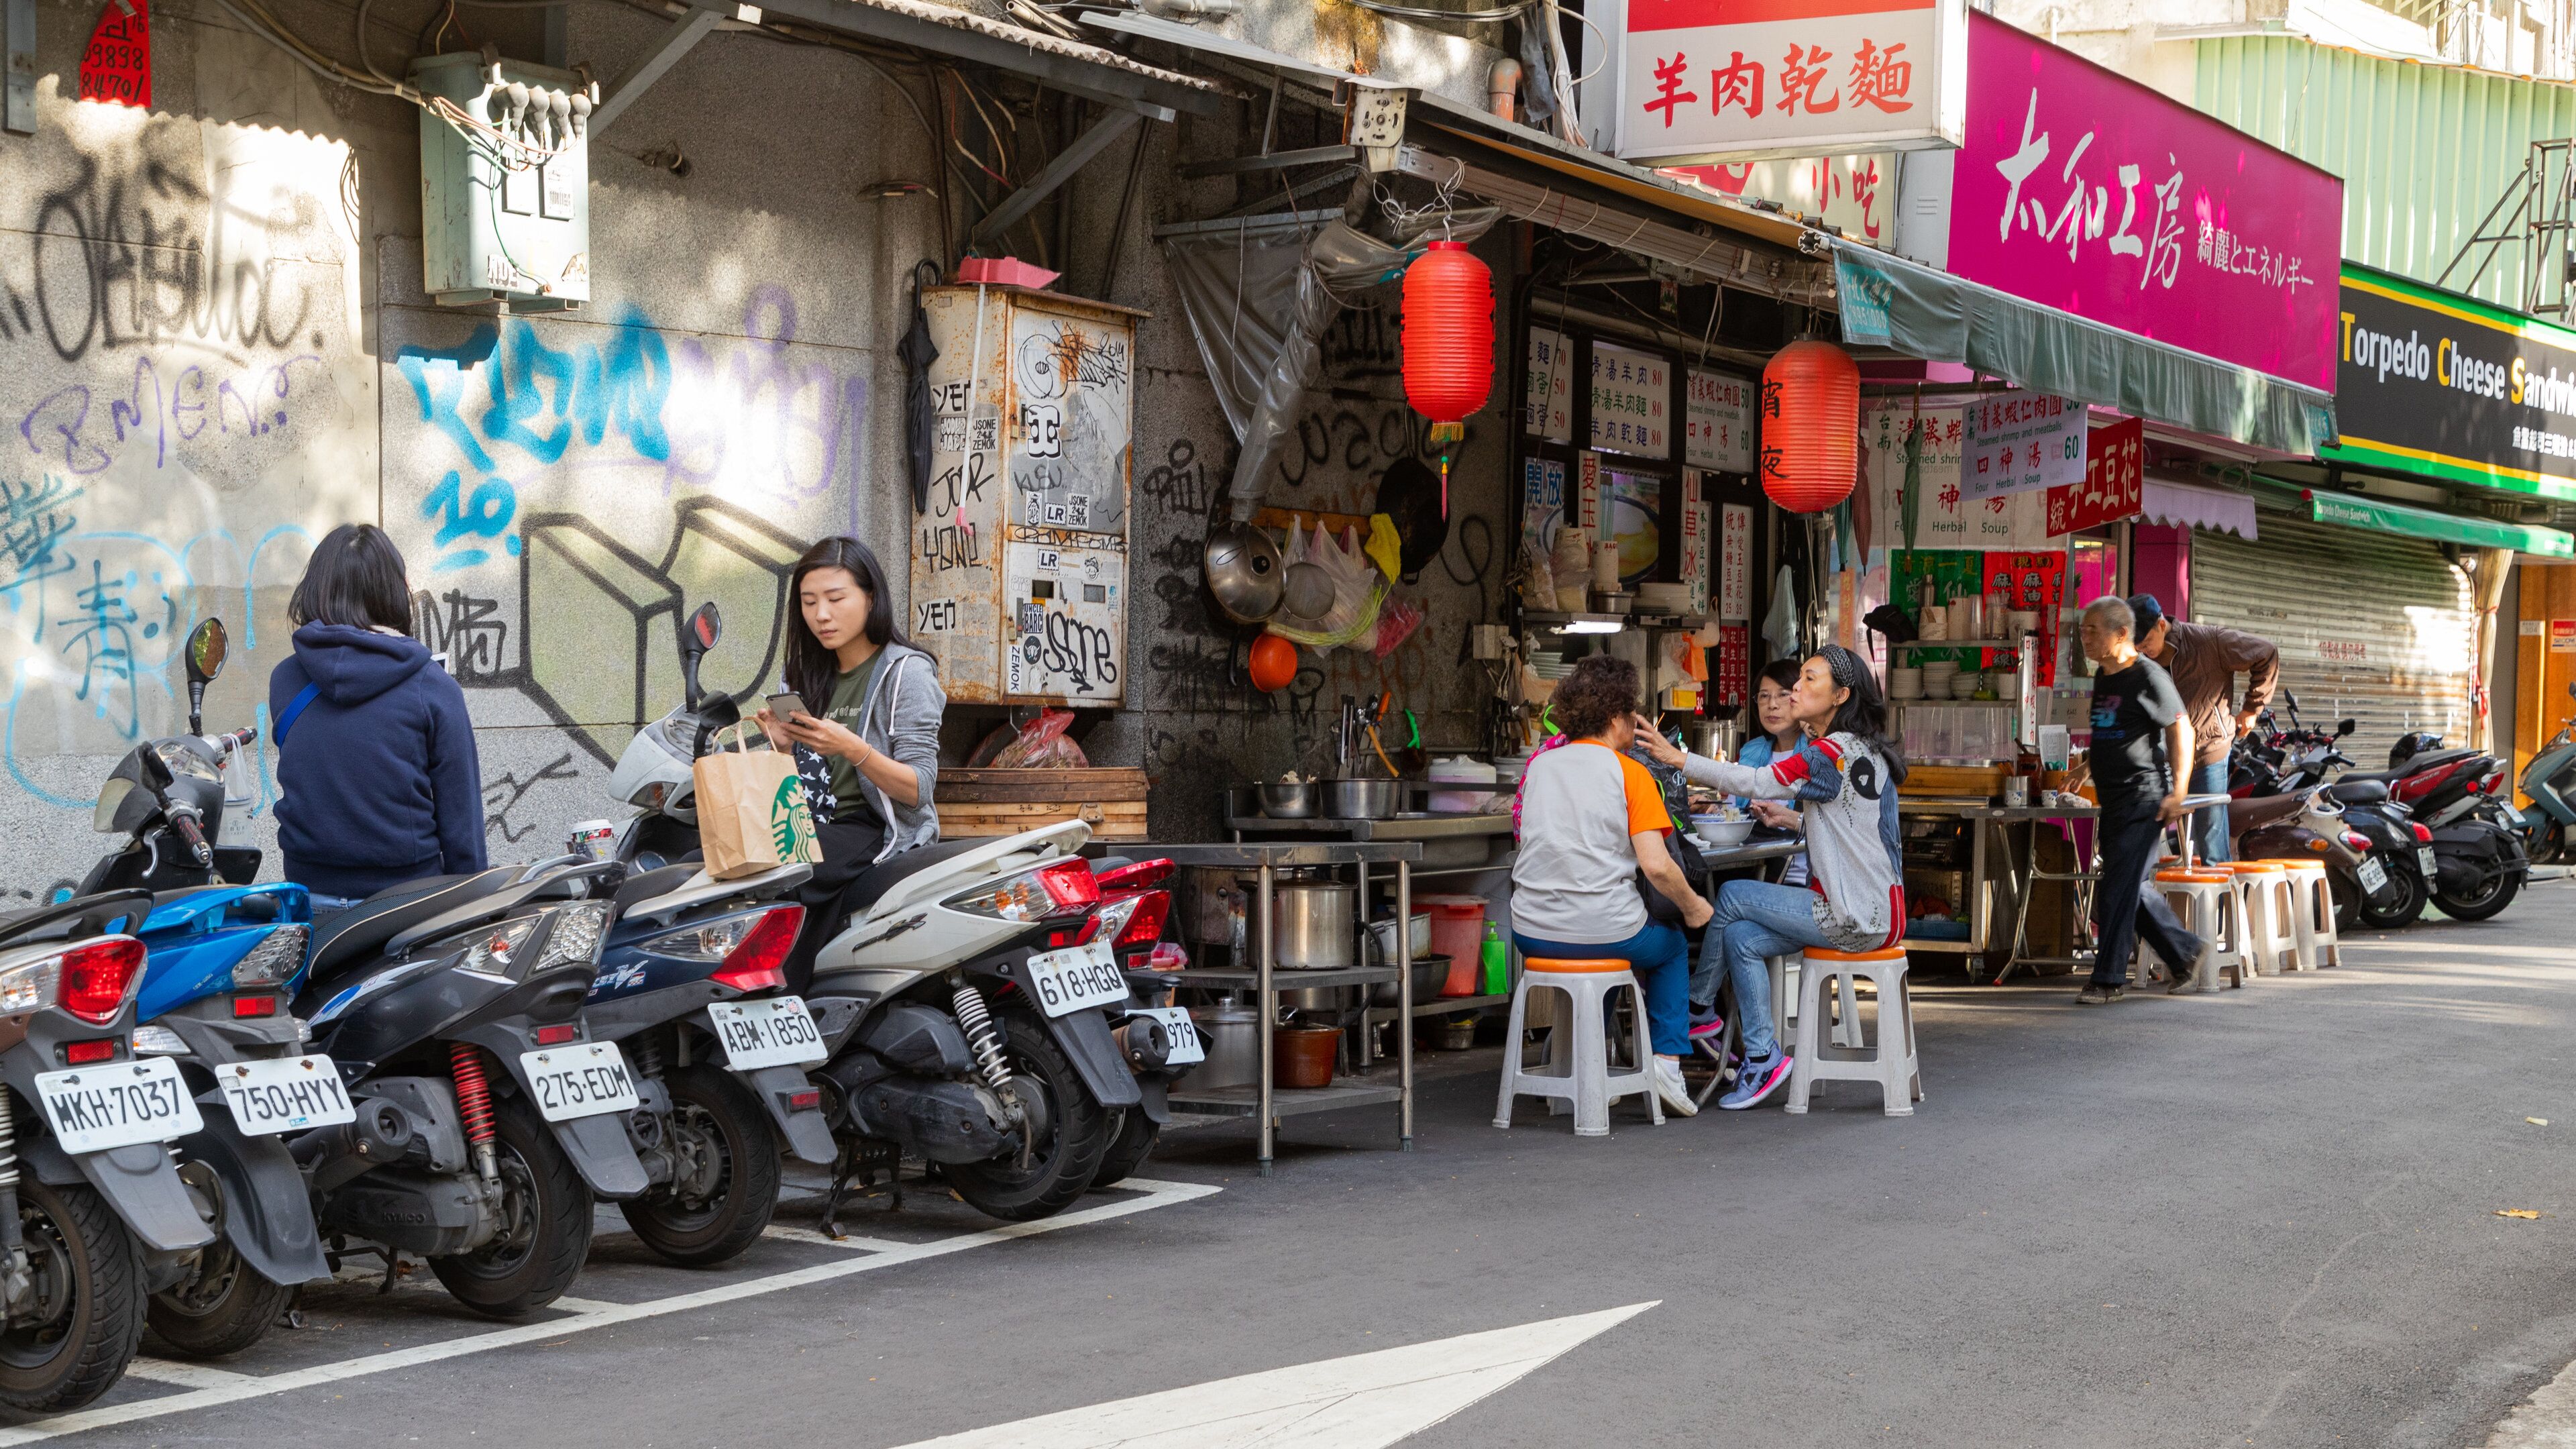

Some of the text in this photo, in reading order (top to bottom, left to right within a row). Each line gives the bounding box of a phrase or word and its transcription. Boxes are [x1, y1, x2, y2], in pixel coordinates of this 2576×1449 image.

[1643, 38, 1914, 129] 羊肉乾麵
[1996, 87, 2184, 290] 太和工房
[2197, 220, 2314, 294] 綺麗とエネルギー
[2341, 311, 2430, 383] Torpedo
[2438, 337, 2506, 400] Cheese
[1554, 377, 1565, 396] 50
[1652, 369, 1662, 386] 80
[1554, 411, 1565, 429] 50
[1652, 400, 1662, 417] 80
[973, 419, 996, 430] JSONE
[1591, 417, 1661, 447] 羊肉乾麵 80
[1688, 420, 1750, 451] 四神湯 60
[1977, 421, 2062, 448] Steamed shrimp and meatballs
[973, 439, 996, 450] ZEMOK
[1976, 435, 2079, 475] 四神湯 60
[1527, 463, 1562, 506] 開放
[1976, 472, 2041, 493] Four Herbal Soup
[1069, 495, 1087, 507] JSONE
[2316, 501, 2334, 517] Torpedo
[2335, 504, 2349, 519] Cheese
[1047, 506, 1064, 521] LR
[1069, 515, 1087, 527] ZEMOK
[1684, 472, 1698, 577] 仙草冰
[1932, 521, 1967, 533] Herbal
[1981, 522, 2009, 535] Soup
[1041, 553, 1057, 567] LR
[1725, 602, 1733, 614] 25
[1735, 604, 1743, 615] 35
[1011, 646, 1020, 692] ZEMOK
[1697, 696, 1704, 711] 30
[1039, 963, 1123, 1006] 618-HGQ
[723, 1014, 817, 1053] ABM-1850
[1169, 1021, 1194, 1049] 979
[537, 1065, 633, 1110] 275-EDM
[50, 1077, 181, 1133] MKH-7037
[229, 1076, 346, 1124] 750-HYY
[382, 1212, 426, 1224] KYMCO
